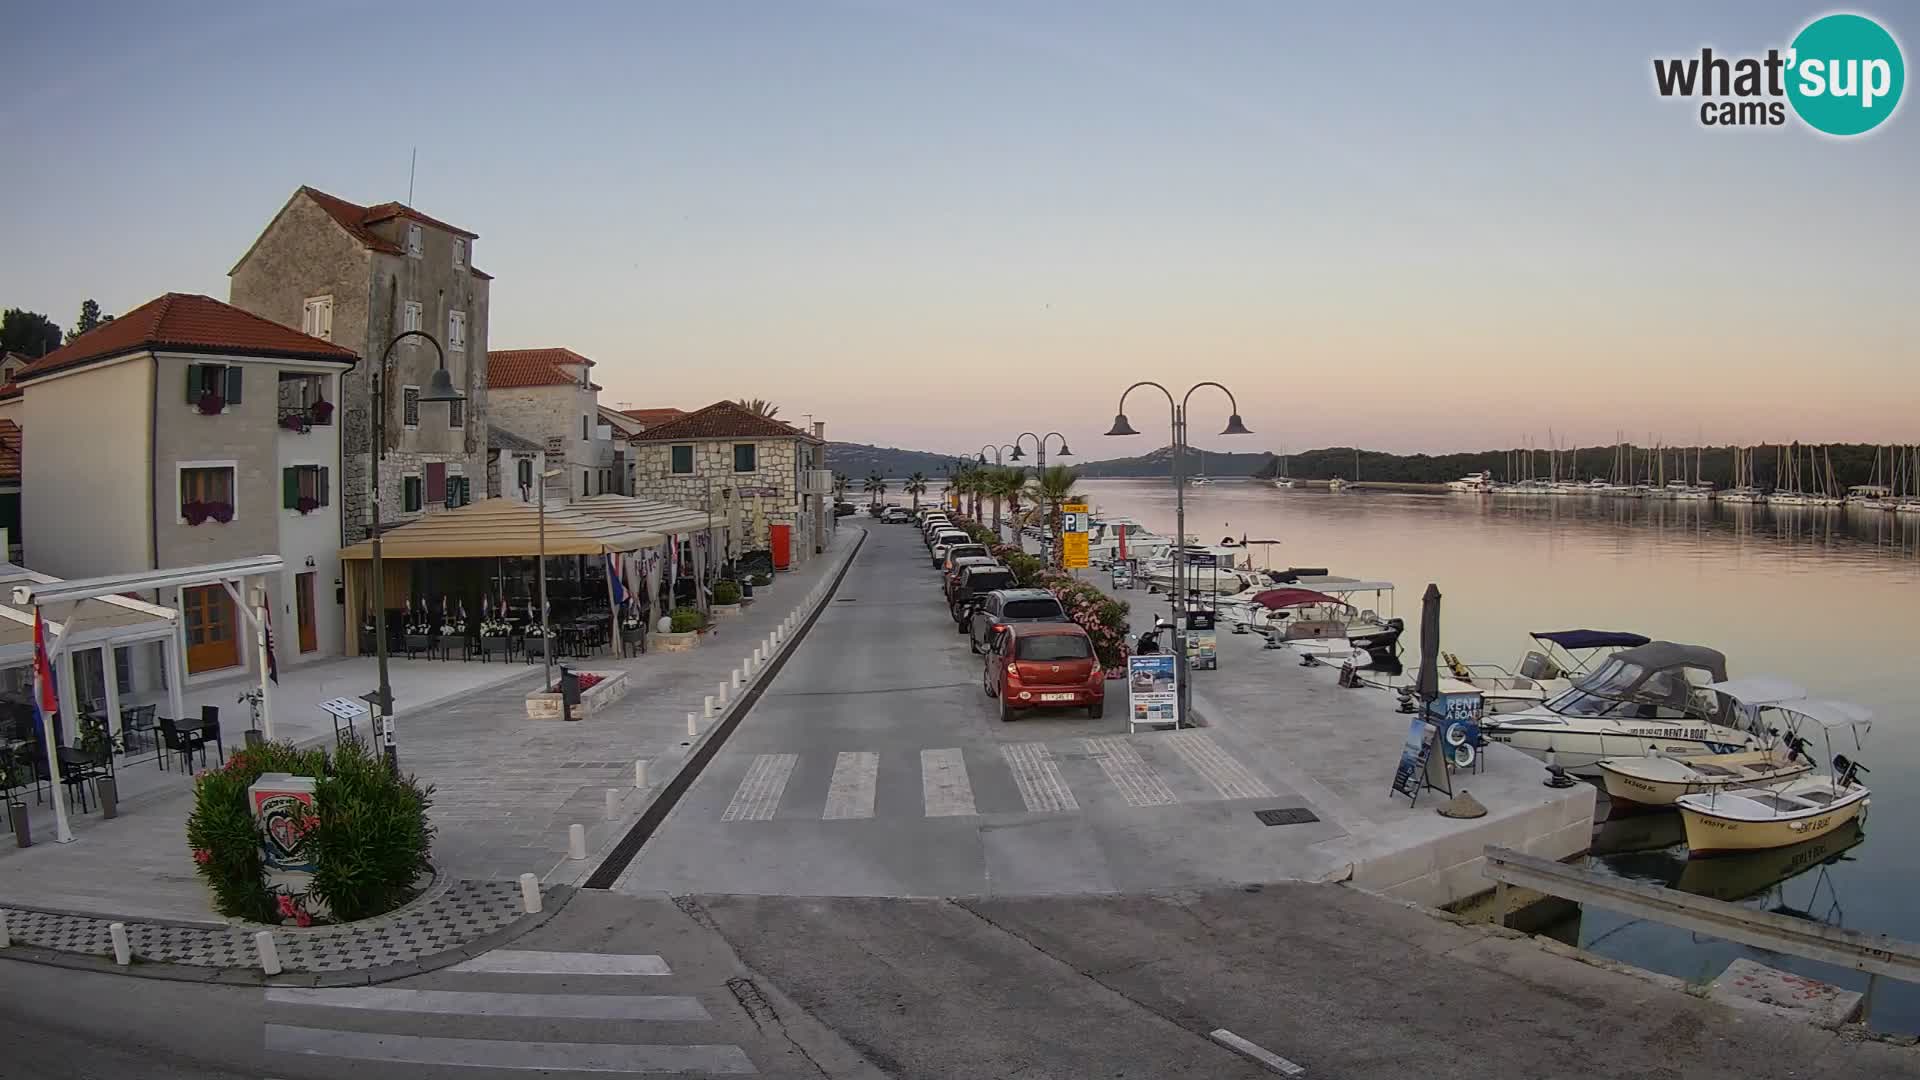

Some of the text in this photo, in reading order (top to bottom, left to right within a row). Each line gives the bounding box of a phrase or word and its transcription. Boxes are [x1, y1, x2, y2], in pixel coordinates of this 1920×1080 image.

[1065, 514, 1076, 531] P
[1446, 698, 1479, 711] RENT
[1445, 709, 1482, 720] A BOAT
[1663, 728, 1683, 737] RENT
[1683, 729, 1689, 738] A
[1689, 729, 1708, 740] BOAT
